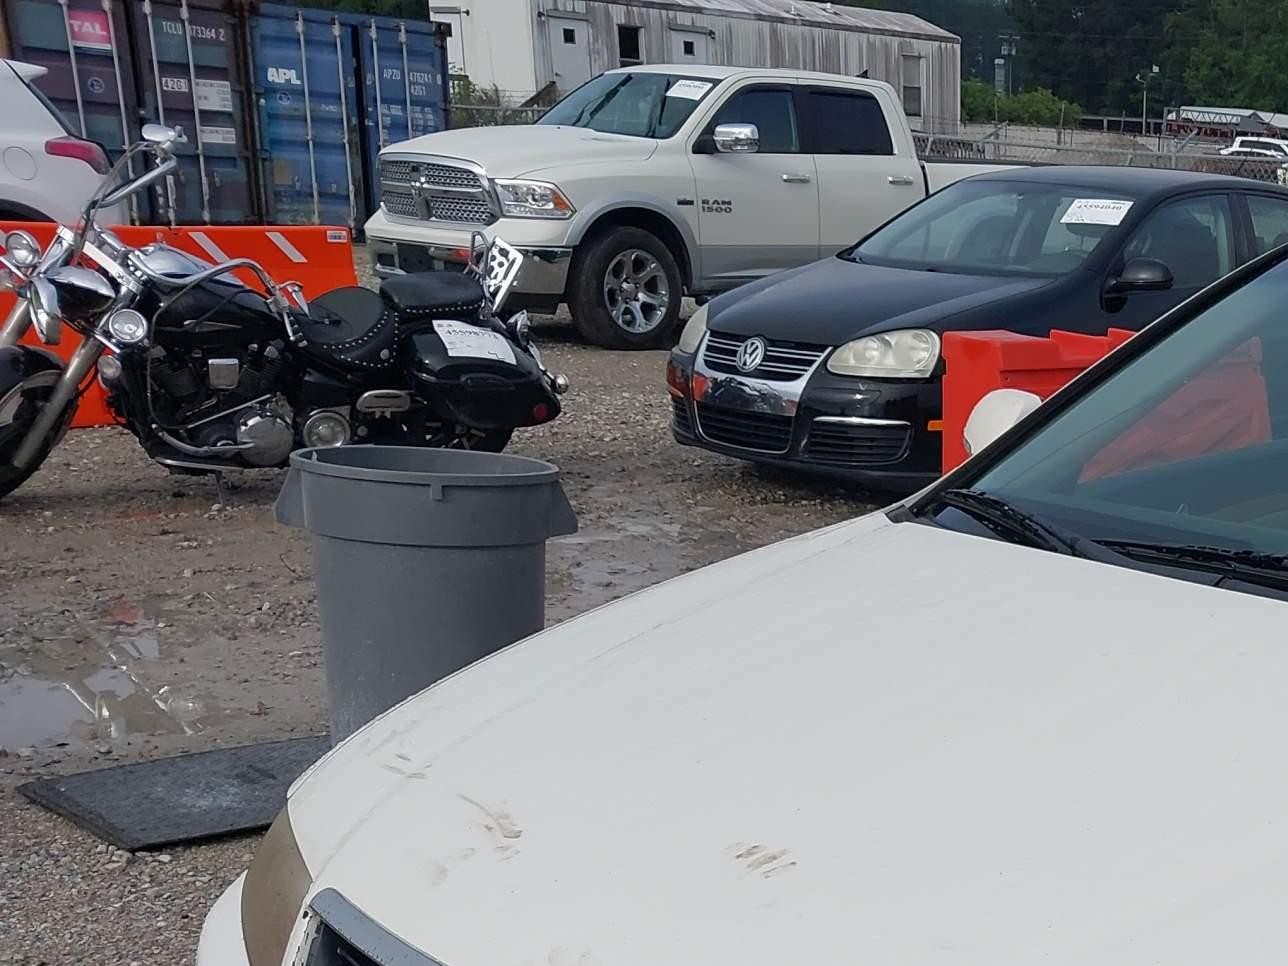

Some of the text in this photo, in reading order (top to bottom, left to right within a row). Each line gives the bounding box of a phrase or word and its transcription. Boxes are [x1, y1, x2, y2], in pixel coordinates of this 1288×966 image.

[69, 19, 107, 36] TAL
[162, 21, 183, 35] TCLU
[267, 67, 302, 85] APL
[383, 68, 401, 81] APZU
[701, 206, 733, 214] 1500
